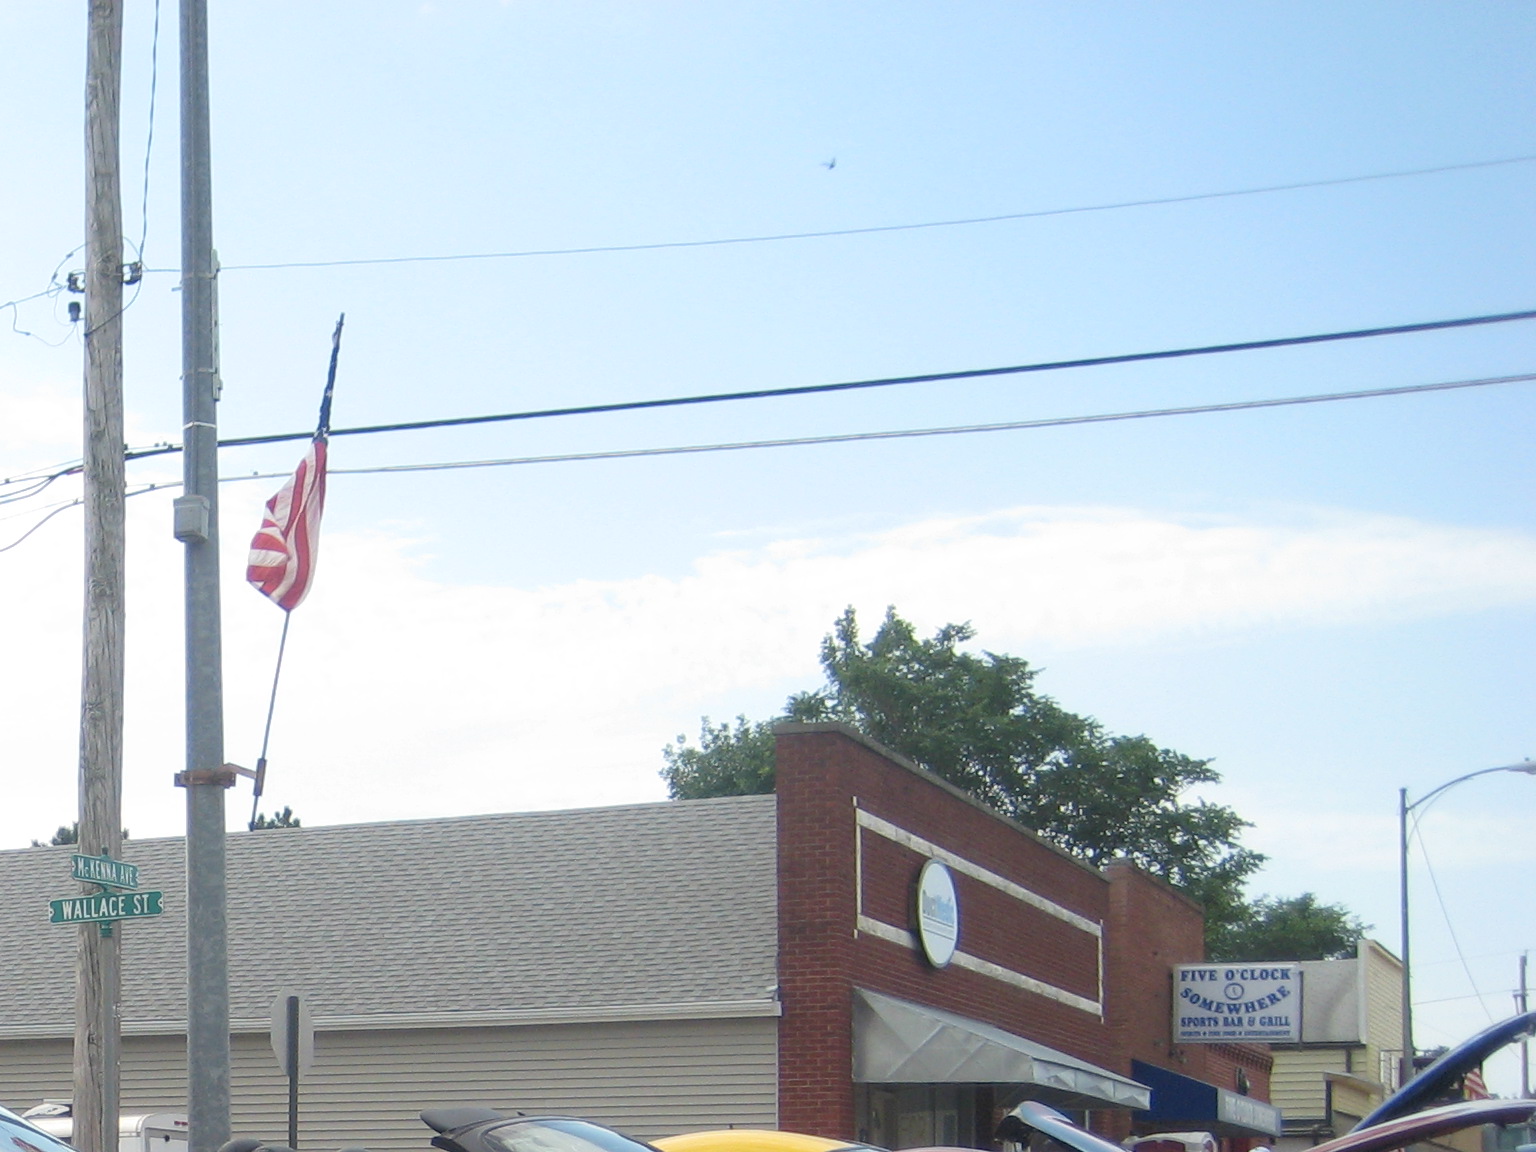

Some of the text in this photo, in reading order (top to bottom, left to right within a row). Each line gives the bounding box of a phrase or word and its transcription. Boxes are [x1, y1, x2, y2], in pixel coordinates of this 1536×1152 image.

[78, 857, 135, 886] McKENNA AVE
[62, 894, 149, 920] WALLACE ST
[1180, 969, 1290, 981] FIVE O'CLOCK
[1180, 985, 1291, 1015] SOMEWHERE
[1180, 1017, 1291, 1027] SPORTS BAR & GRILL
